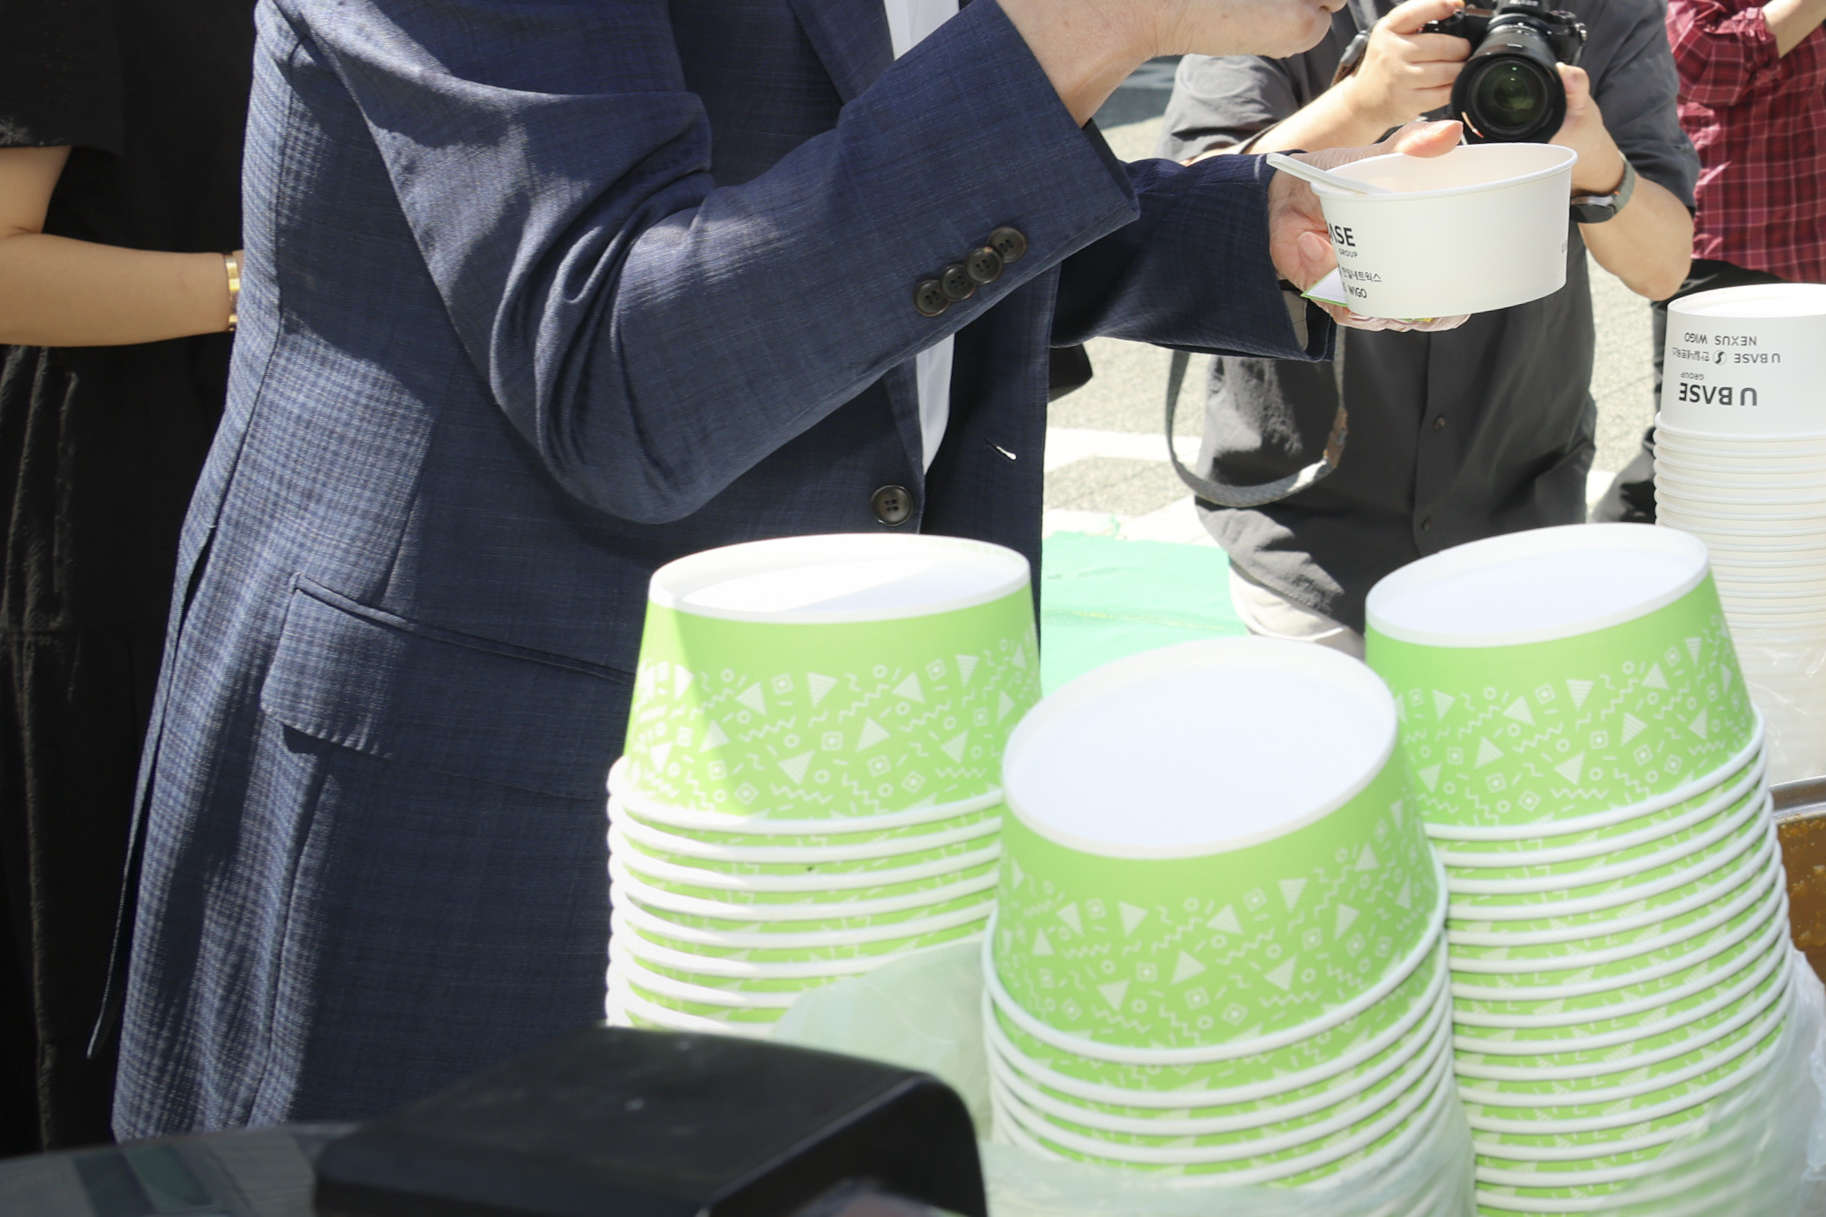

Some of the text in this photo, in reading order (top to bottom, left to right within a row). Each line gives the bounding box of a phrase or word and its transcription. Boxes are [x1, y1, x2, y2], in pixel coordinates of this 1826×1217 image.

[1329, 223, 1356, 247] ASE
[1683, 332, 1758, 346] NEXUS WIGO
[1680, 371, 1705, 381] GROUP
